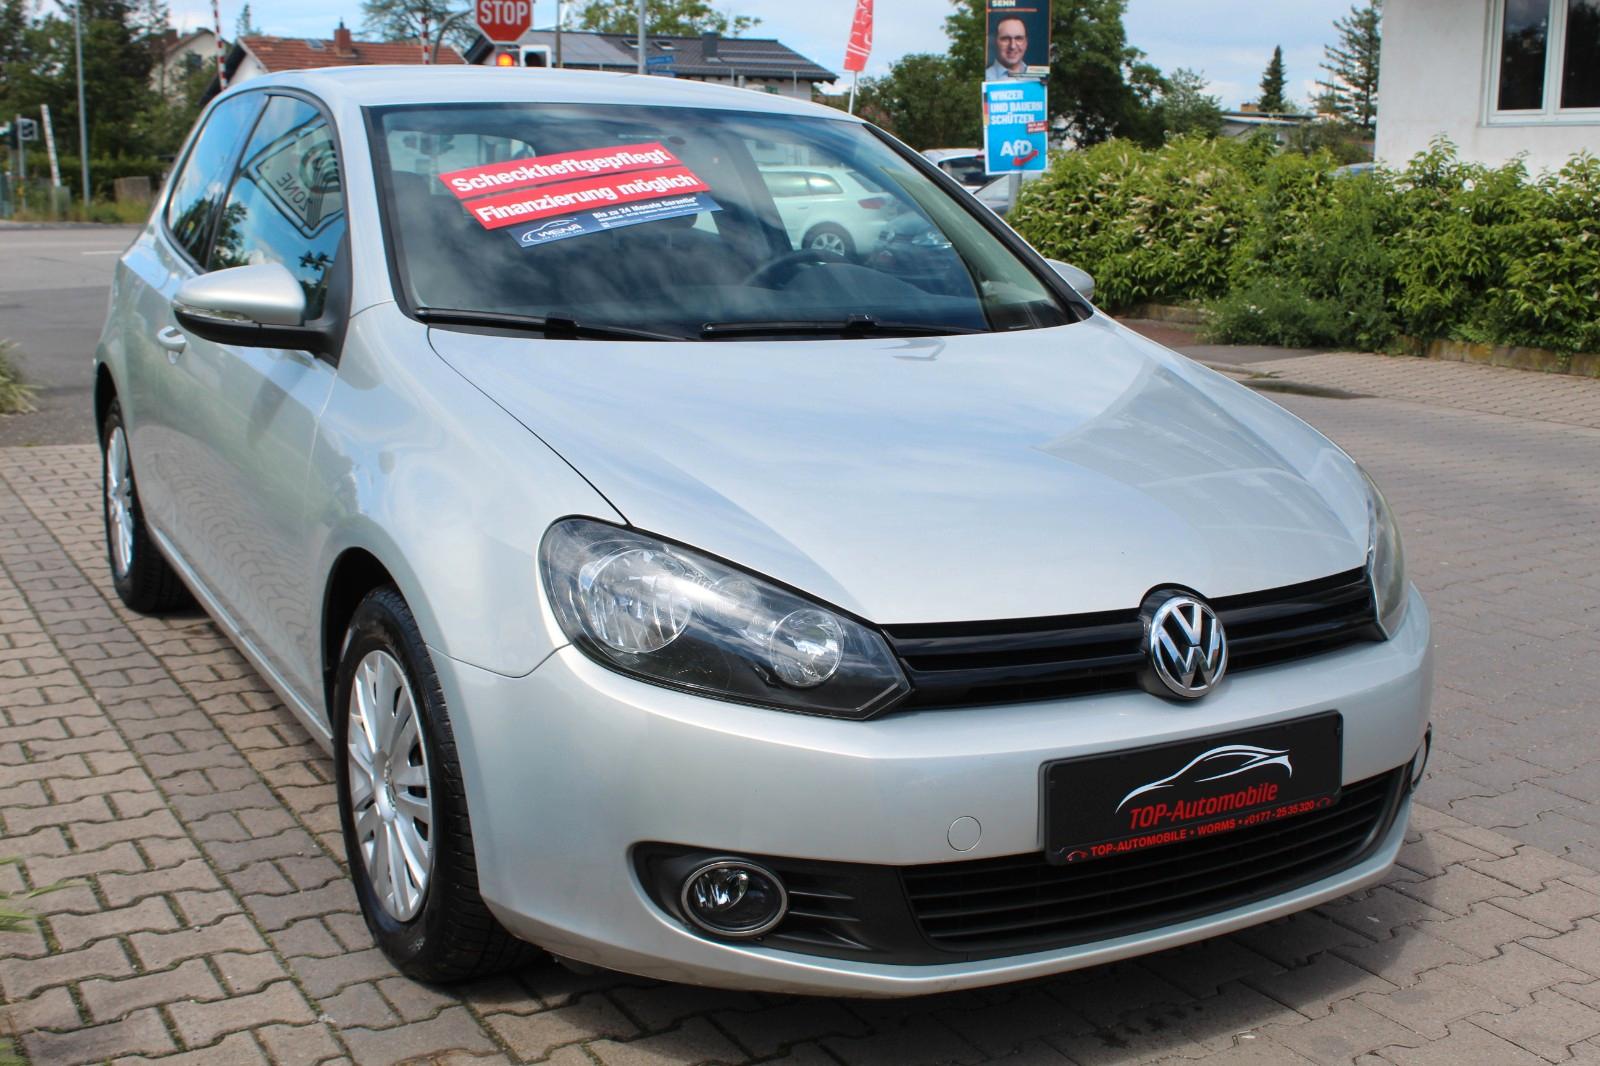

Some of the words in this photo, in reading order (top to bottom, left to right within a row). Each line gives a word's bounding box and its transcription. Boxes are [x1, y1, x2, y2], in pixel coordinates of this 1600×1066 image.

[480, 1, 528, 25] STOP
[990, 102, 1008, 112] UND
[1010, 101, 1043, 111] BAUERN
[990, 112, 1035, 125] SCHÜTZEN
[1000, 139, 1033, 157] AfD
[452, 149, 671, 192] Scheckheftgepflegt
[475, 186, 616, 222] Finanzierung
[617, 174, 698, 195] möglich
[1155, 598, 1226, 694] VW
[1130, 782, 1279, 830] TOP-Automobile
[1090, 828, 1187, 856] TOP-AUTOMOBILE
[1197, 817, 1236, 837] WORMS
